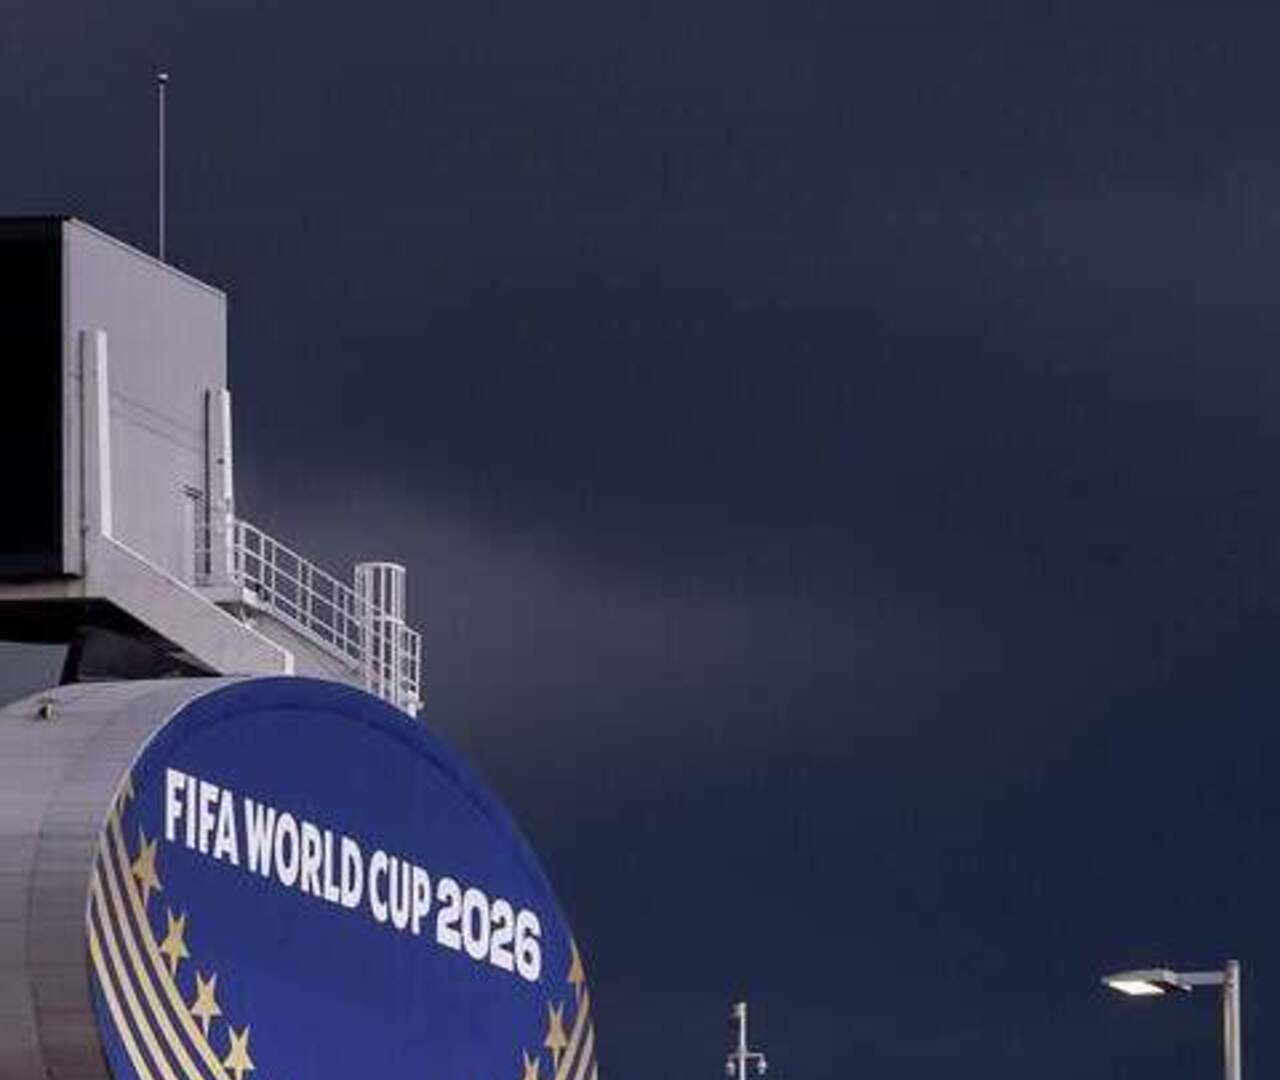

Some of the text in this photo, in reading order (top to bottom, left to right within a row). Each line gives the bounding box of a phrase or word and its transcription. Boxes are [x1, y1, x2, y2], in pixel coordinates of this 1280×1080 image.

[163, 767, 542, 983] FIFA WORLD CUP 2026
